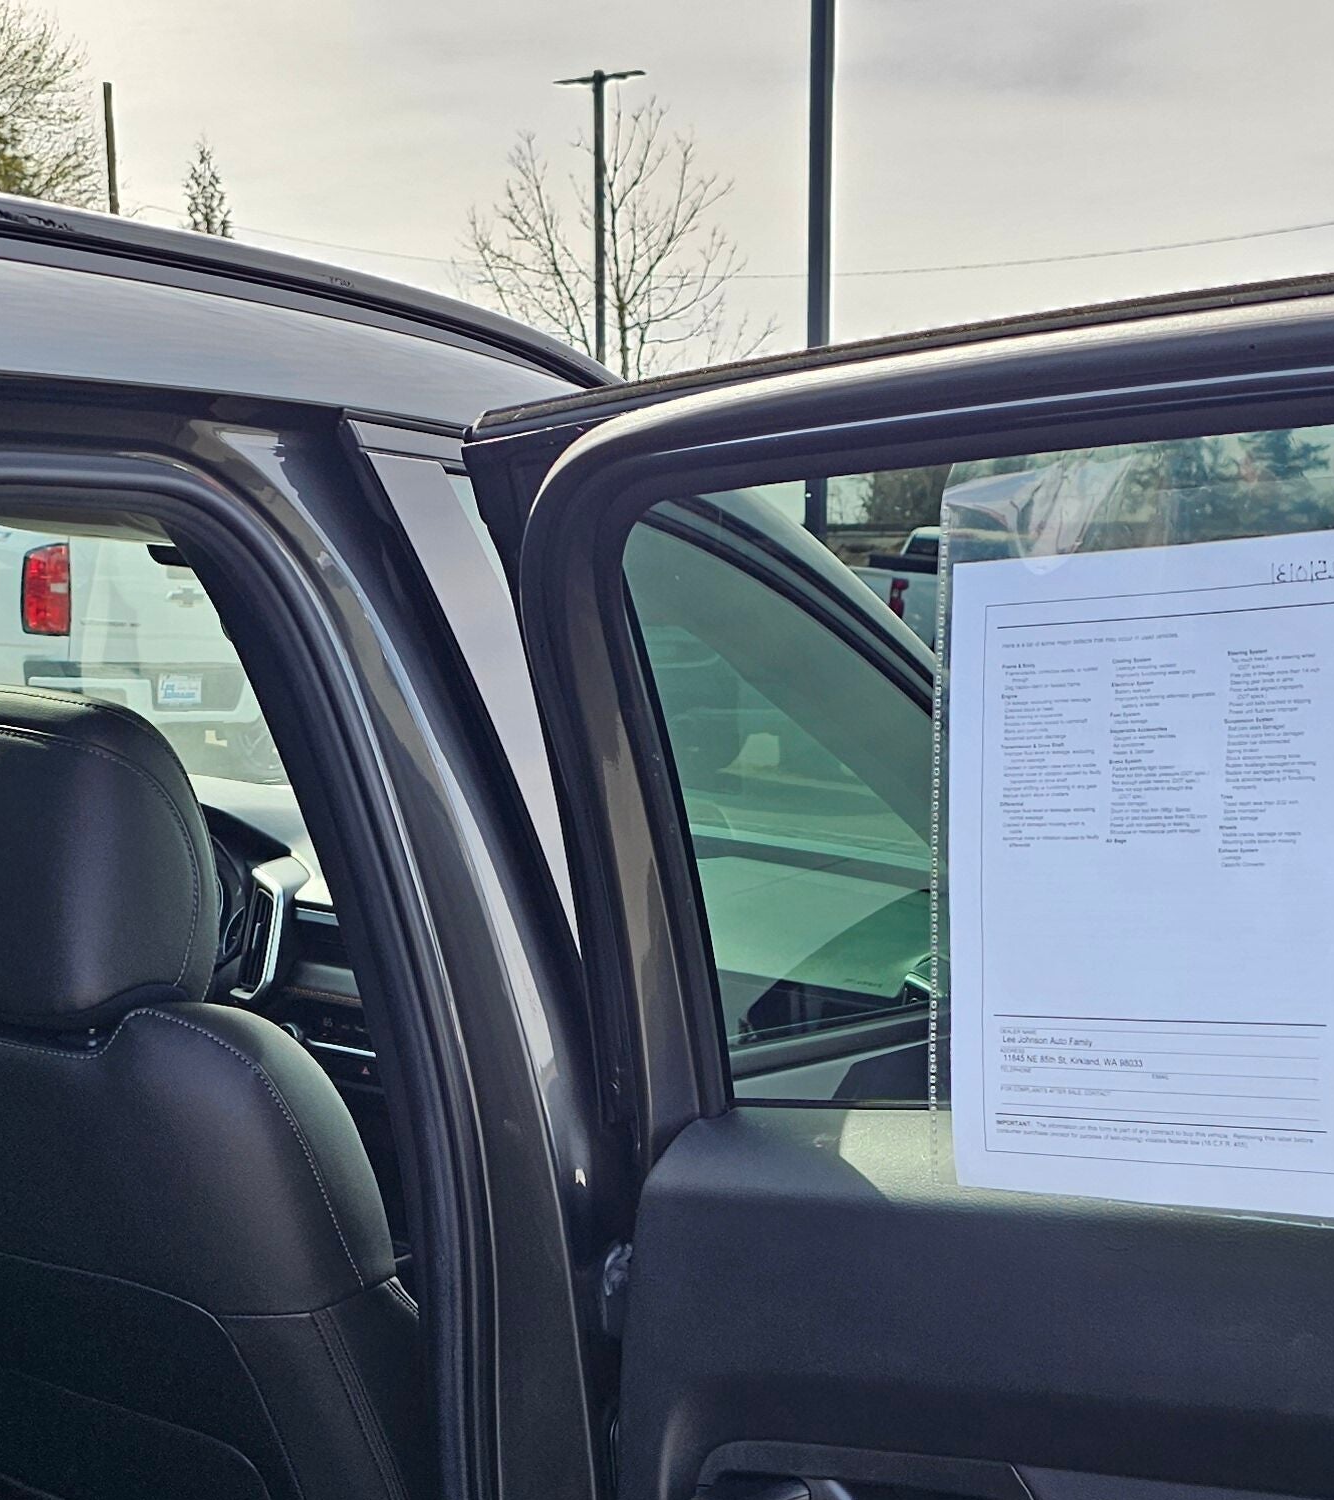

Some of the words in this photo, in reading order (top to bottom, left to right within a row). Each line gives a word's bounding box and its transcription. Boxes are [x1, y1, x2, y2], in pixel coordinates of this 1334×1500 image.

[1002, 1035, 1016, 1043] Lee
[1018, 1036, 1048, 1045] Johnson
[1050, 1037, 1067, 1045] Auto
[1069, 1037, 1093, 1048] Family
[1027, 1055, 1038, 1063] NE
[1104, 1058, 1118, 1066] WA
